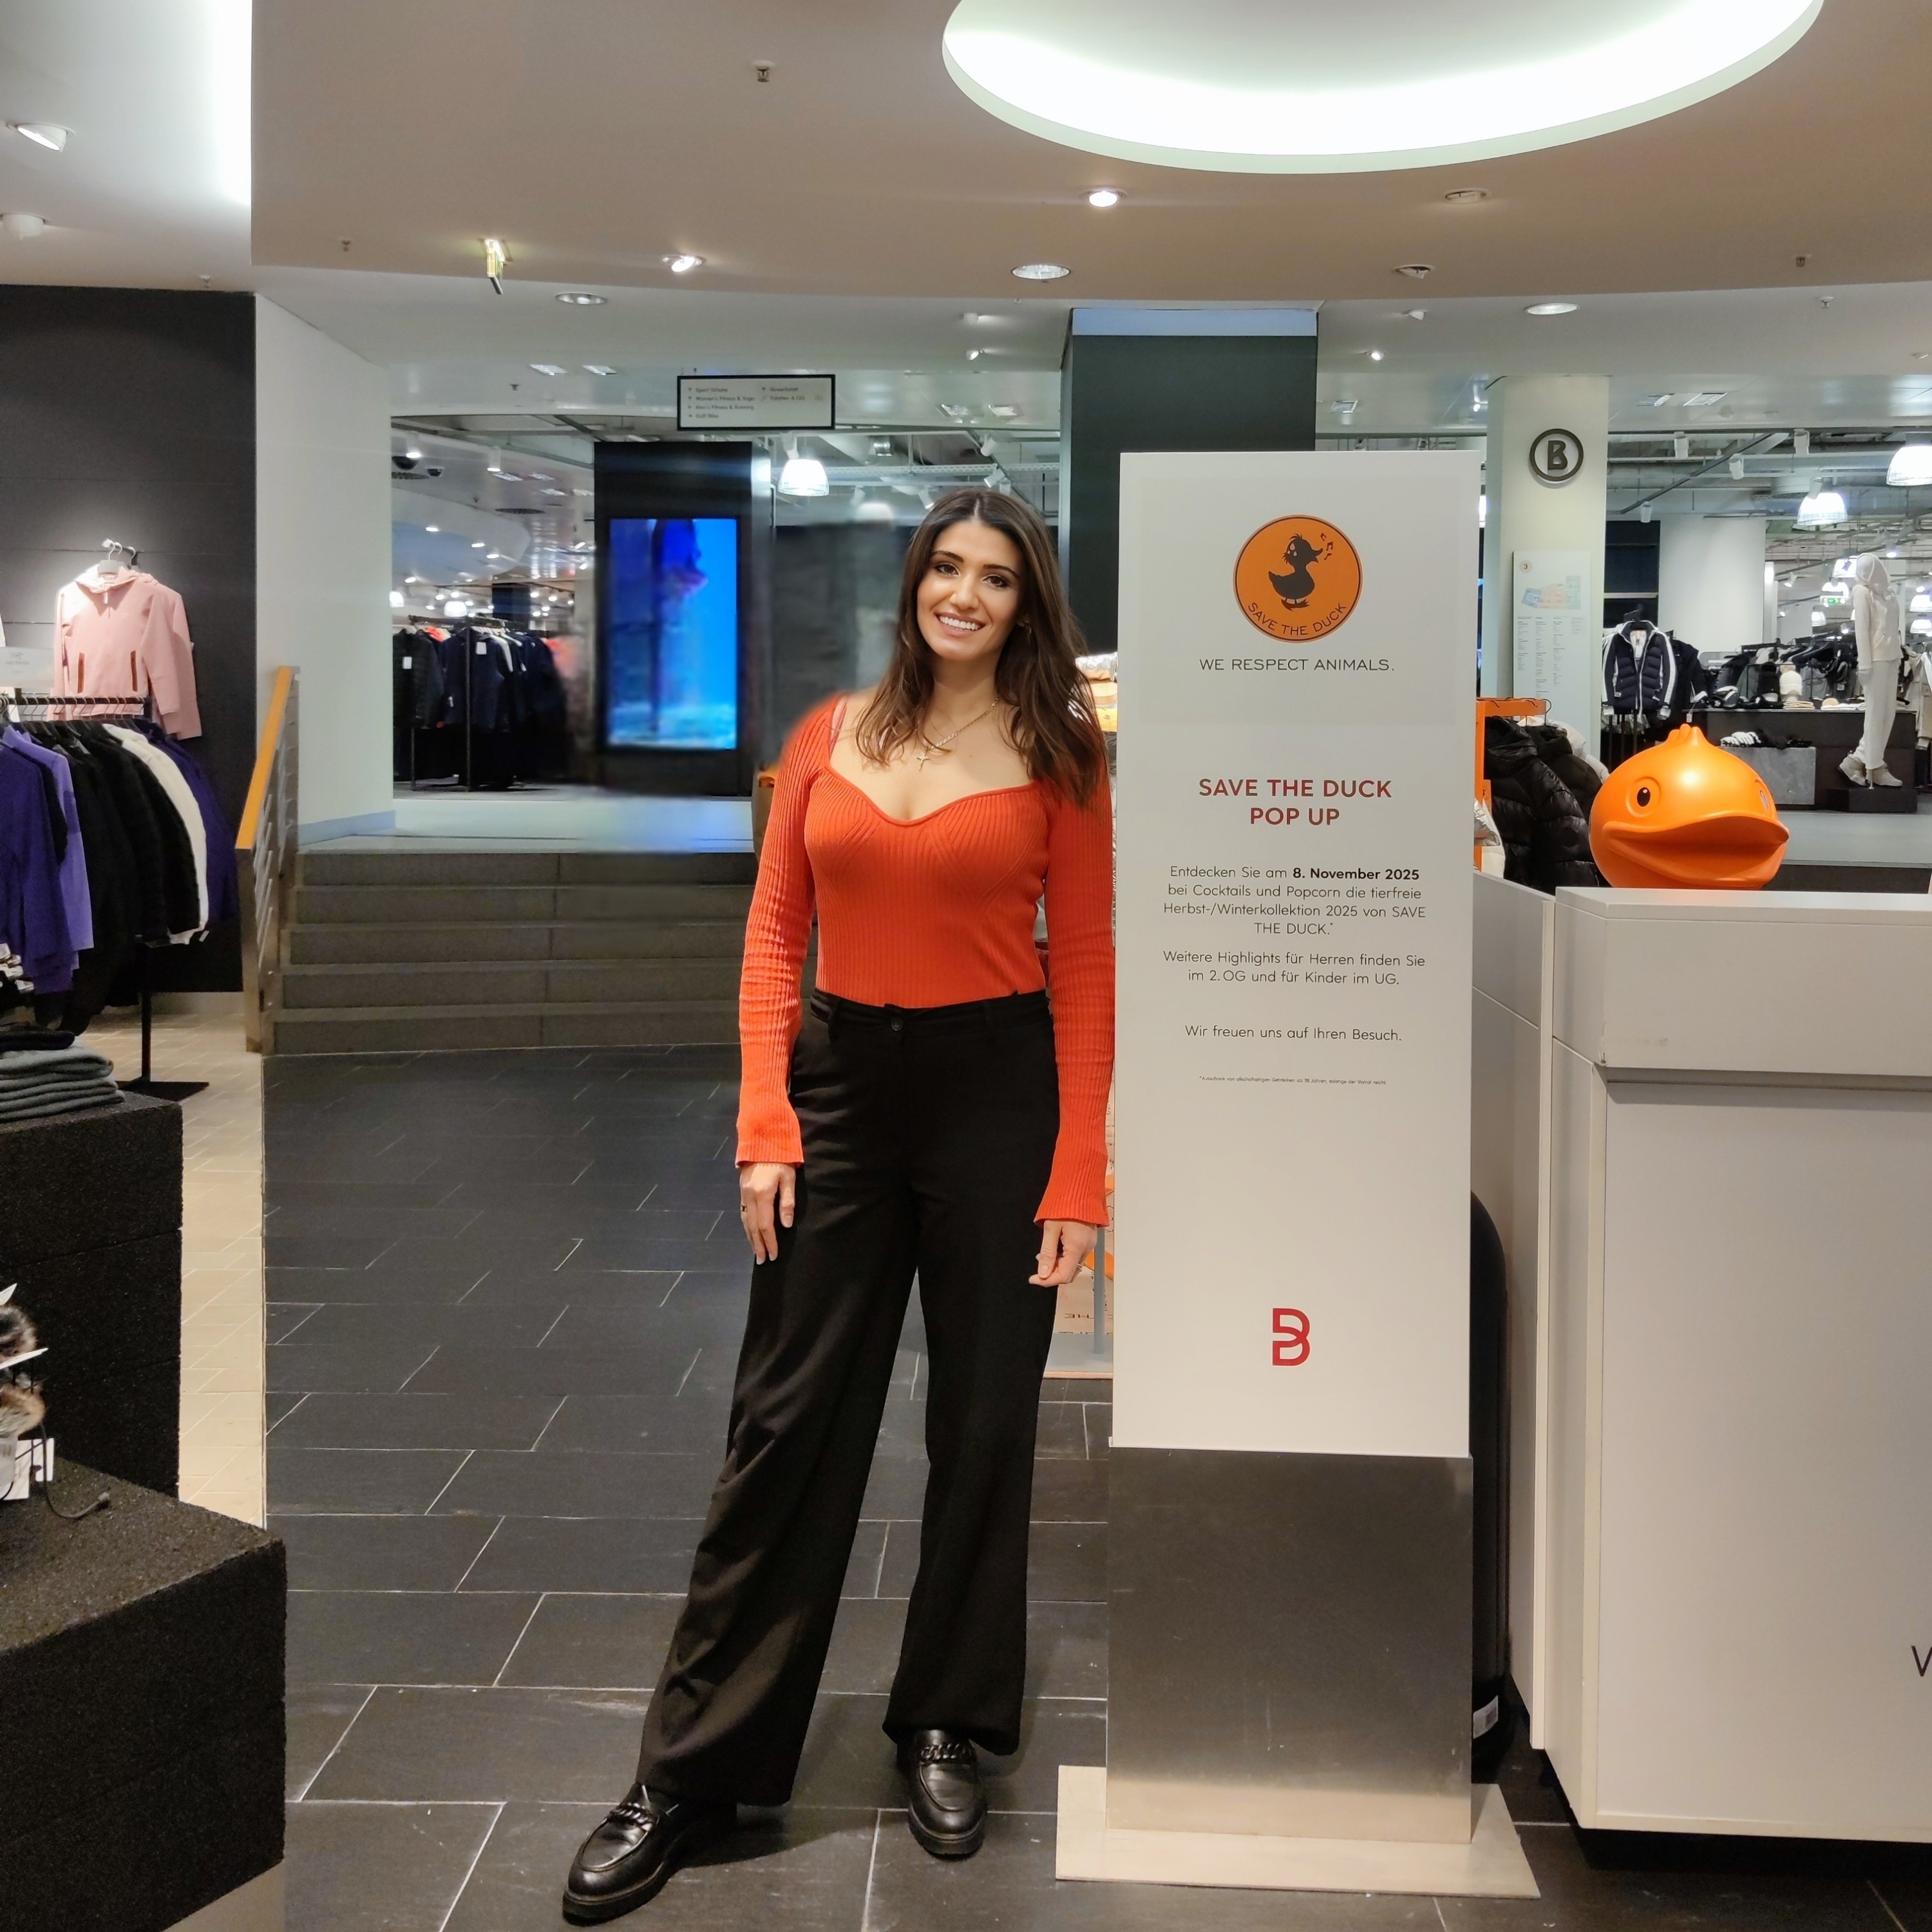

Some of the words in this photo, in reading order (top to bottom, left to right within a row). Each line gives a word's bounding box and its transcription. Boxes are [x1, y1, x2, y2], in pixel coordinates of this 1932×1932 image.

[1548, 440, 1567, 469] B
[1248, 602, 1278, 630] SAVE
[1282, 625, 1308, 636] THE
[1312, 603, 1347, 632] DUCK
[1200, 659, 1224, 670] WE
[1232, 659, 1309, 670] RESPECT
[1314, 659, 1394, 671] ANIMALS.
[1199, 779, 1258, 796] SAVE
[1267, 779, 1313, 797] THE
[1323, 780, 1392, 797] DUCK
[1251, 808, 1300, 825] POP
[1309, 808, 1340, 826] UP
[1171, 866, 1235, 877] Entdecken
[1242, 867, 1260, 878] Sie
[1293, 867, 1305, 878] 8.
[1311, 867, 1381, 879] November
[1385, 869, 1419, 880] 2025
[1169, 884, 1187, 895] bei
[1193, 884, 1251, 896] Cocktails
[1256, 885, 1280, 896] und
[1287, 886, 1340, 900] Popcorn
[1346, 886, 1365, 898] die
[1370, 887, 1421, 899] tierfreie
[1164, 902, 1320, 916] Herbst-/Winterkollektion
[1326, 905, 1357, 916] 2025
[1363, 909, 1386, 917] von
[1392, 906, 1426, 918] SAVE
[1254, 922, 1280, 934] THE
[1163, 951, 1212, 962] Weitere
[1218, 951, 1280, 966] Highlights
[1285, 952, 1303, 964] für
[1310, 954, 1354, 965] Herren
[1360, 953, 1400, 966] finden
[1406, 955, 1425, 966] Sie
[1189, 969, 1203, 981] im
[1252, 971, 1275, 982] und
[1281, 971, 1300, 982] für
[1306, 971, 1347, 983] Kinder
[1354, 972, 1368, 984] im
[1376, 973, 1399, 985] UG.
[1185, 1025, 1208, 1036] Wir
[1213, 1025, 1254, 1037] freuen
[1260, 1030, 1282, 1038] uns
[1287, 1027, 1309, 1038] auf
[1314, 1027, 1346, 1039] Ihren
[1353, 1029, 1401, 1041] Besuch.
[1273, 1308, 1310, 1365] B
